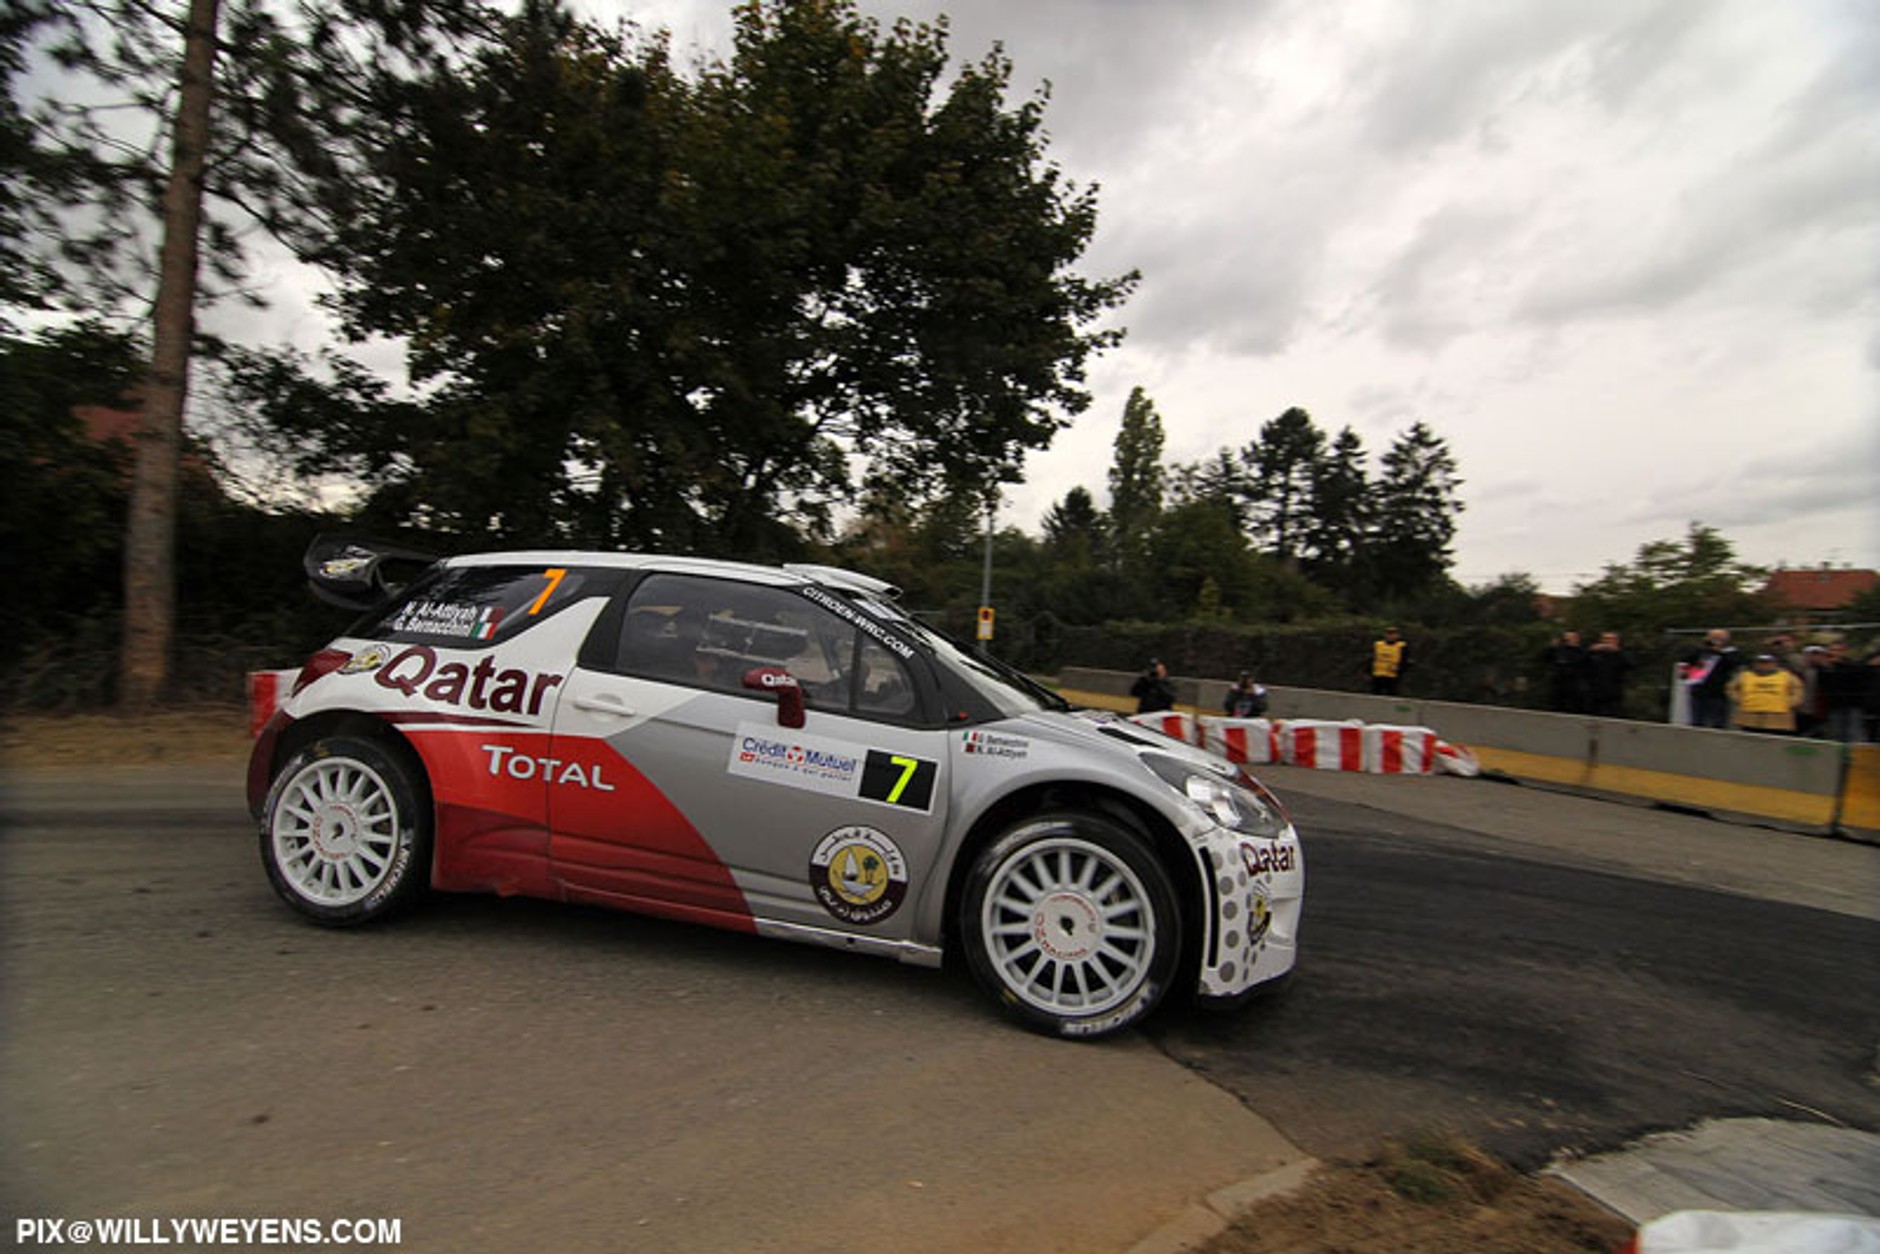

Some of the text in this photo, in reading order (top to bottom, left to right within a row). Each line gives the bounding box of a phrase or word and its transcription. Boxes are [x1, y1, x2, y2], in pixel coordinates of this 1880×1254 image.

[528, 568, 567, 615] 7
[374, 646, 563, 715] Qatar
[482, 744, 615, 791] TOTAL
[742, 737, 787, 758] Crédit
[806, 749, 857, 773] Mutuel
[886, 755, 918, 803] 7
